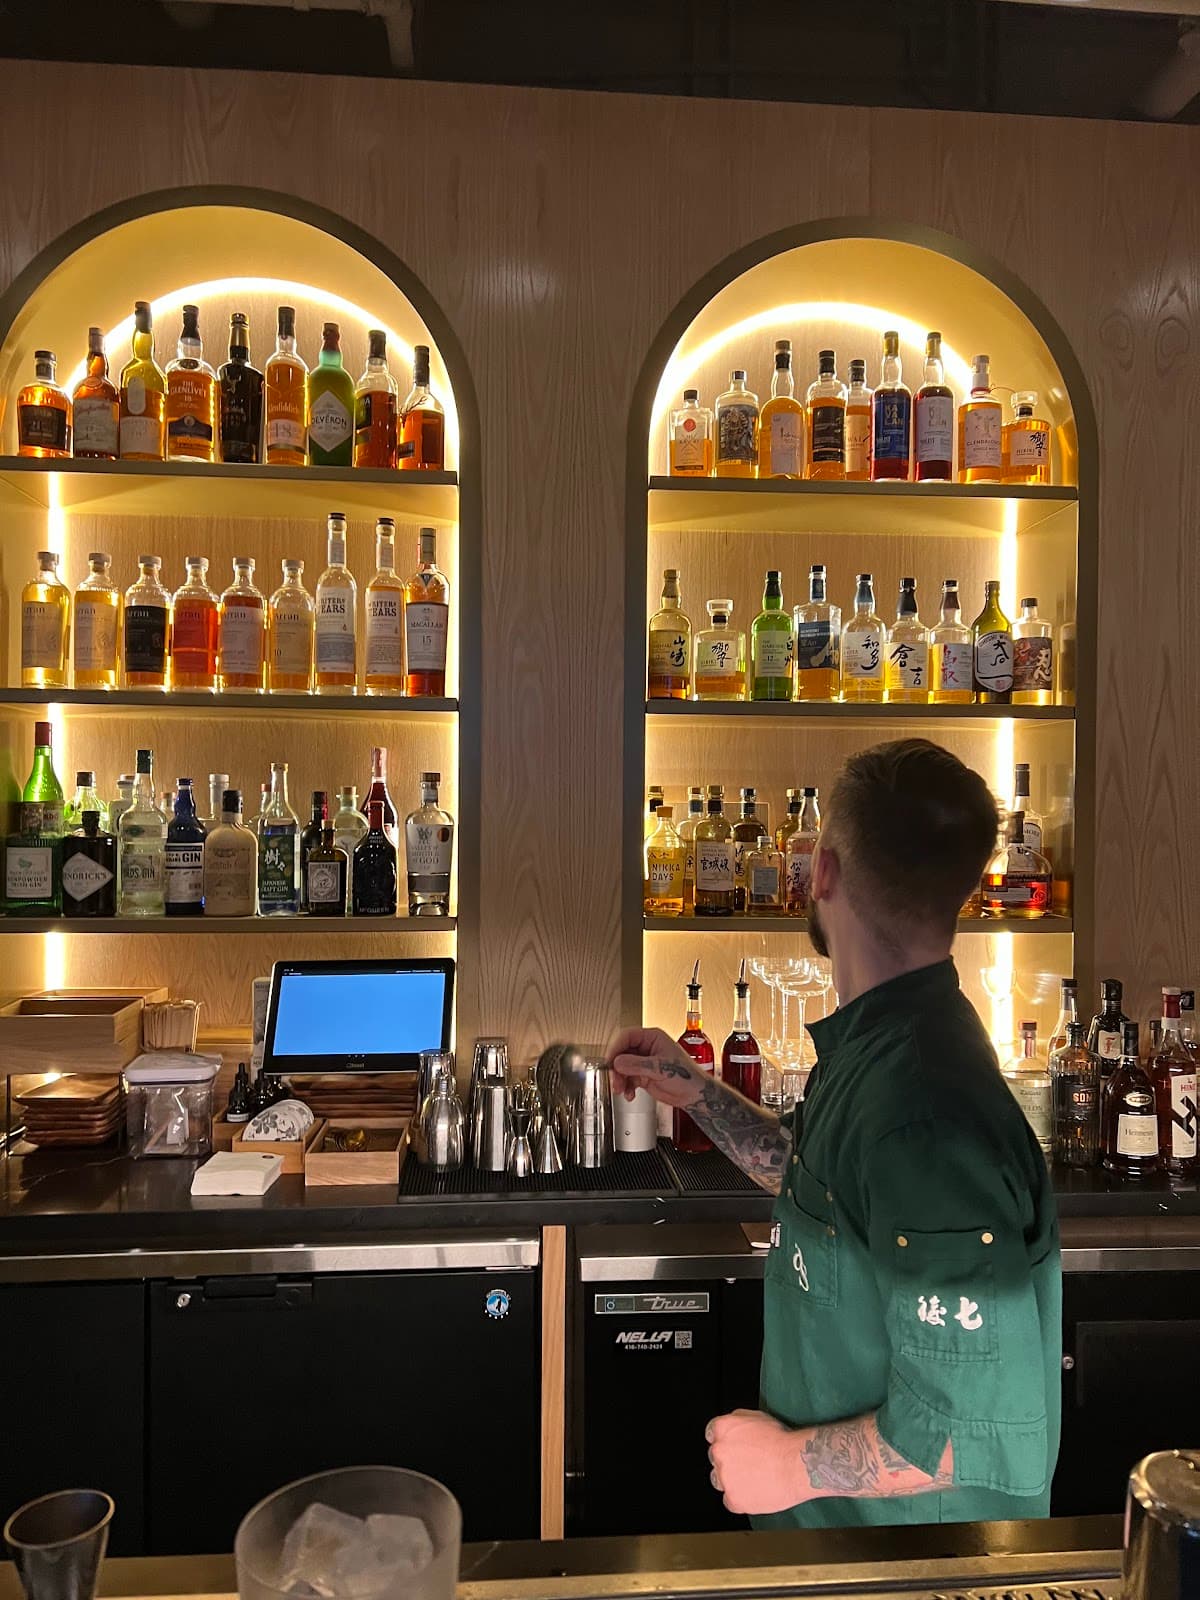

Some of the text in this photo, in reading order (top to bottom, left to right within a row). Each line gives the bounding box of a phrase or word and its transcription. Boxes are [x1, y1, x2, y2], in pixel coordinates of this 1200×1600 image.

[275, 422, 292, 438] 18
[422, 635, 432, 645] 15
[182, 852, 201, 863] GIN
[652, 863, 680, 872] NIKKA
[652, 873, 674, 881] DAYS
[643, 1296, 704, 1310] True
[615, 1330, 674, 1344] NELLA
